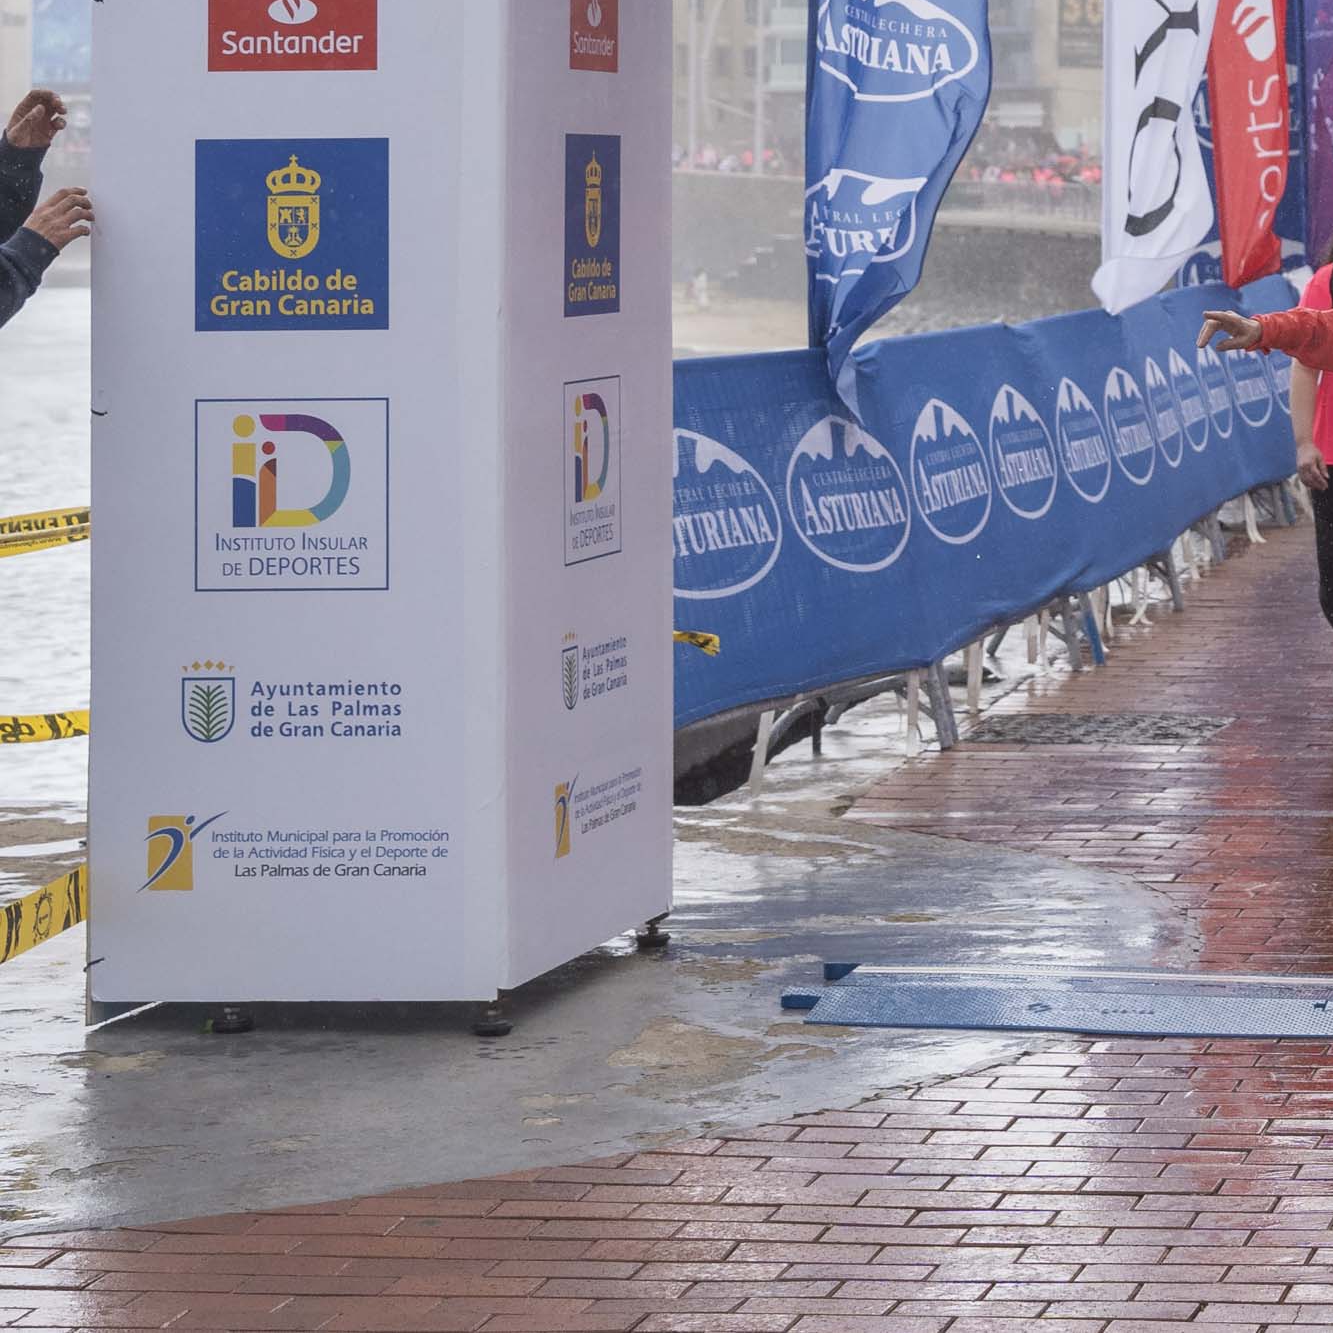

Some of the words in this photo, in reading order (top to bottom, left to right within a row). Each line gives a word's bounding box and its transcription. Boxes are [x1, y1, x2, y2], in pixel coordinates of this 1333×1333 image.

[222, 31, 363, 54] Santander
[574, 30, 615, 57] Santander
[223, 269, 319, 291] Cabildo
[326, 269, 357, 290] de
[211, 295, 270, 315] Gran
[279, 294, 373, 315] Canaria
[918, 458, 990, 515] ASTURIANA
[799, 477, 907, 537] ASTURIANA
[673, 504, 776, 557] TURIANA
[216, 533, 295, 551] INSTITUTO
[303, 532, 367, 550] INSULAR
[223, 563, 242, 576] DE
[250, 557, 360, 575] DEPORTES
[251, 680, 401, 700] Ayuntamiento
[251, 701, 274, 716] de
[288, 702, 318, 716] Las
[332, 700, 401, 716] Palmas
[251, 721, 273, 737] de
[280, 722, 323, 737] Gran
[331, 721, 400, 736] Canaria
